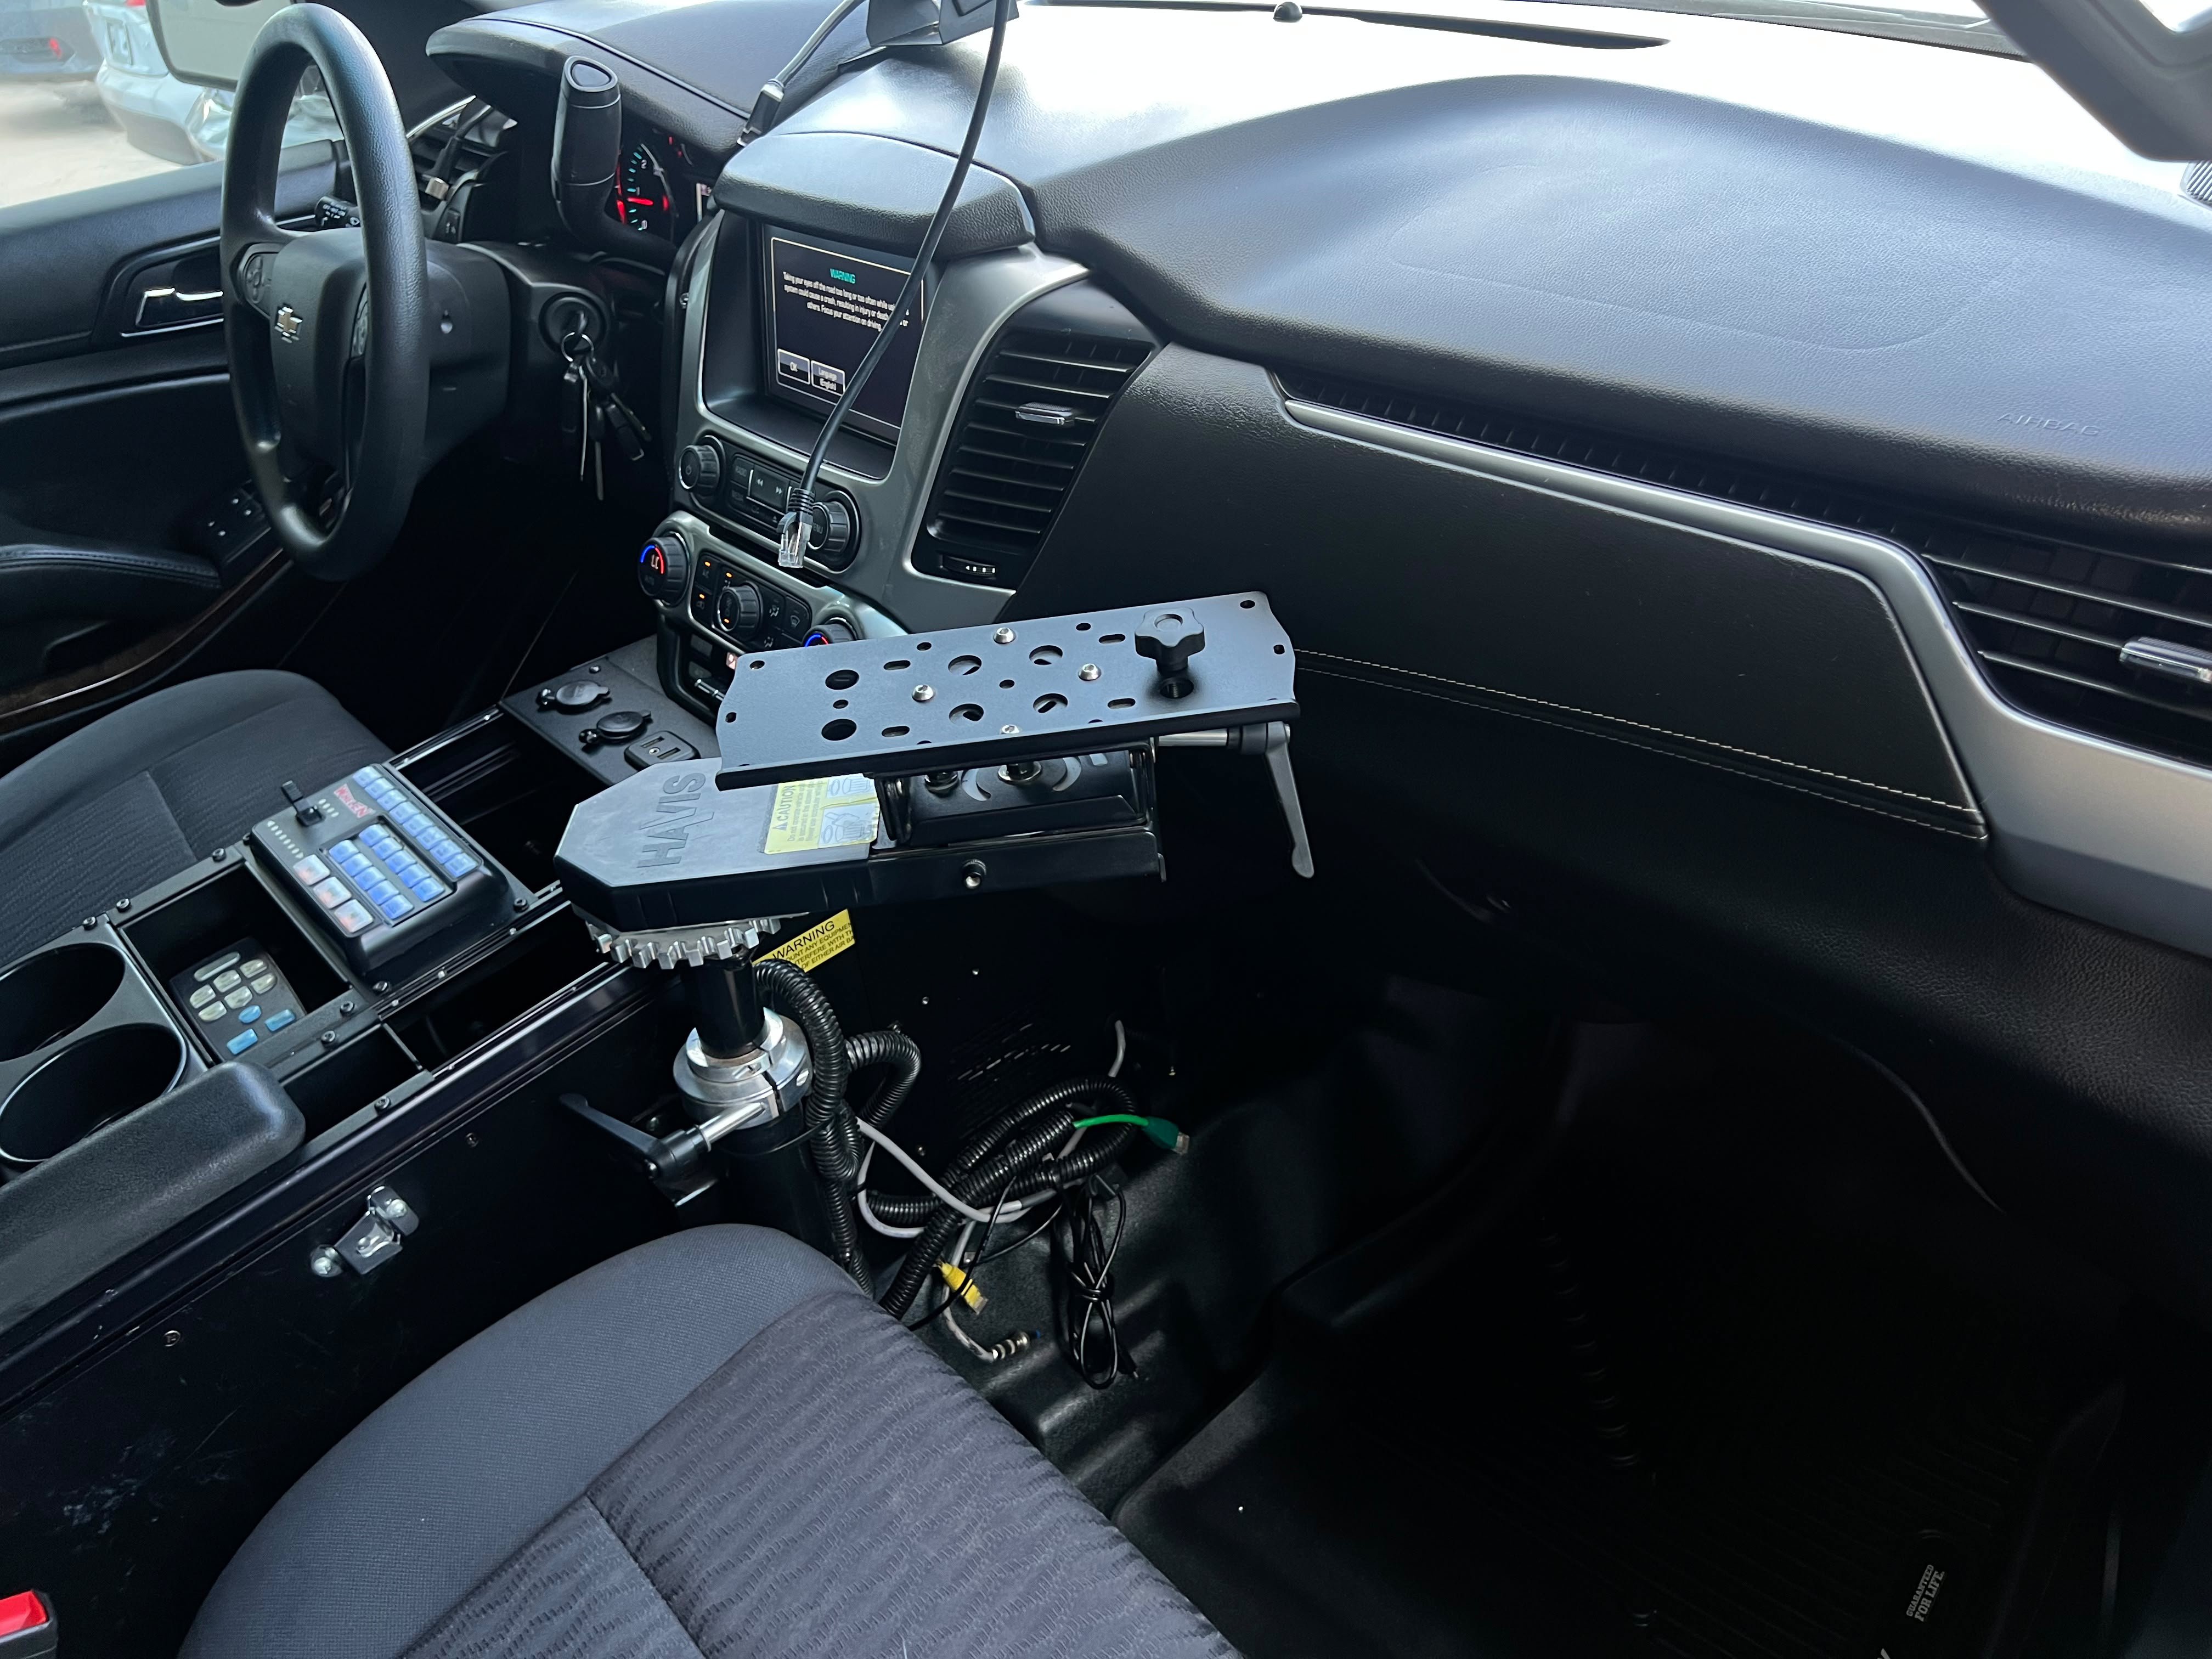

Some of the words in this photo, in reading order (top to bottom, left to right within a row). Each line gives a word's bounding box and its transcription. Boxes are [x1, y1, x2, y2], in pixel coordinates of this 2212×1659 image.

[783, 271, 795, 284] Taking
[804, 279, 813, 288] eyes
[826, 286, 836, 294] road
[843, 289, 852, 301] long
[865, 296, 877, 306] often
[877, 300, 888, 309] while
[830, 268, 856, 284] WARNING
[785, 285, 798, 294] system
[798, 289, 809, 297] could
[809, 292, 820, 301] cause
[837, 300, 854, 313] resulting
[855, 304, 859, 312] in
[859, 305, 871, 318] injury
[821, 304, 833, 315] Focus
[843, 313, 861, 324] attention
[1997, 413, 2102, 436] AIRBAG
[636, 772, 714, 868] HAVIS
[777, 785, 795, 822] CAUTION
[772, 921, 835, 959] WARNING
[786, 950, 804, 961] OUNT
[805, 941, 818, 953] ANY
[820, 923, 851, 945] EQUIPMEN
[795, 944, 827, 964] TERFERE
[828, 933, 845, 946] WITH
[801, 961, 809, 970] OF
[811, 947, 835, 964] EITHER
[834, 941, 845, 951] AIR
[1906, 1564, 1934, 1617] GUARANTEED
[1914, 1597, 1932, 1622] FOR
